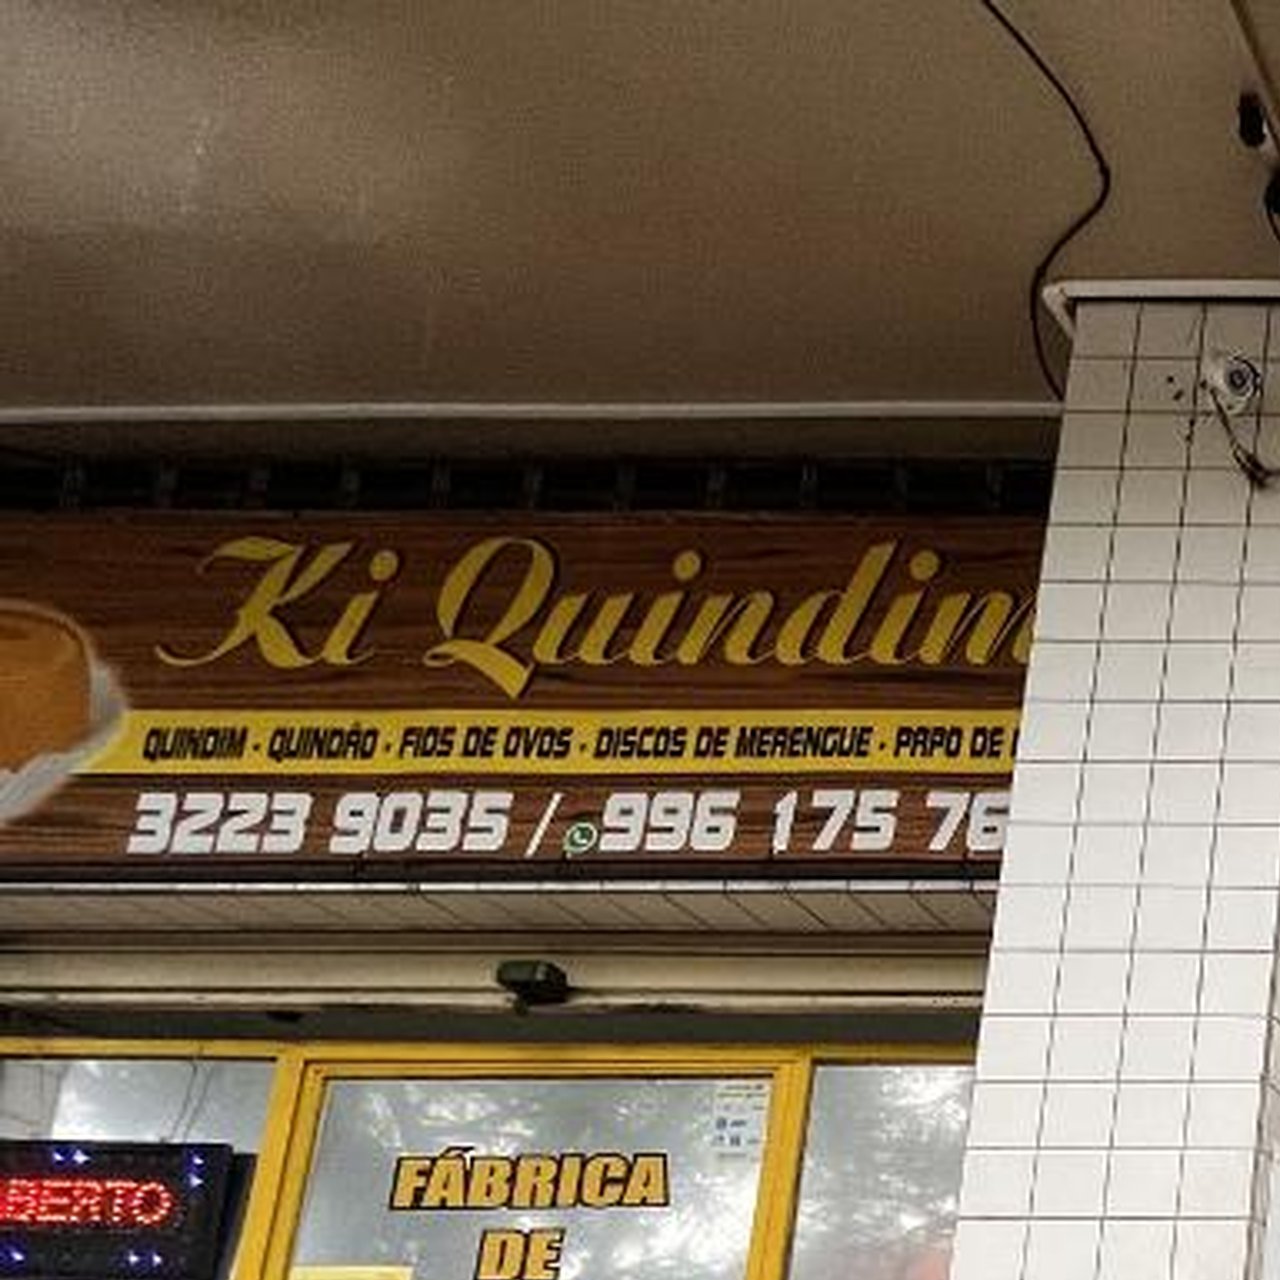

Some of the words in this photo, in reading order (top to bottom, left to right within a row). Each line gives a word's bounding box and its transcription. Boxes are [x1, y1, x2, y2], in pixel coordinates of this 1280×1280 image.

[154, 536, 400, 669] Ki
[423, 536, 1037, 698] Quindim
[143, 727, 248, 762] QUINDIM
[399, 726, 457, 759] FIOS
[461, 726, 498, 758] DE
[503, 726, 574, 759] OVOS
[593, 726, 687, 759] DISCOS
[694, 726, 729, 758] DE
[735, 725, 873, 758] MERENGUE
[893, 725, 963, 758] PAPO
[970, 726, 1004, 758] DE
[126, 791, 313, 854] 3223
[329, 791, 514, 854] 9035
[600, 788, 741, 853] 996
[772, 789, 900, 854] 175
[0, 1178, 172, 1225] BERTO
[389, 1146, 669, 1210] FÁBRICA
